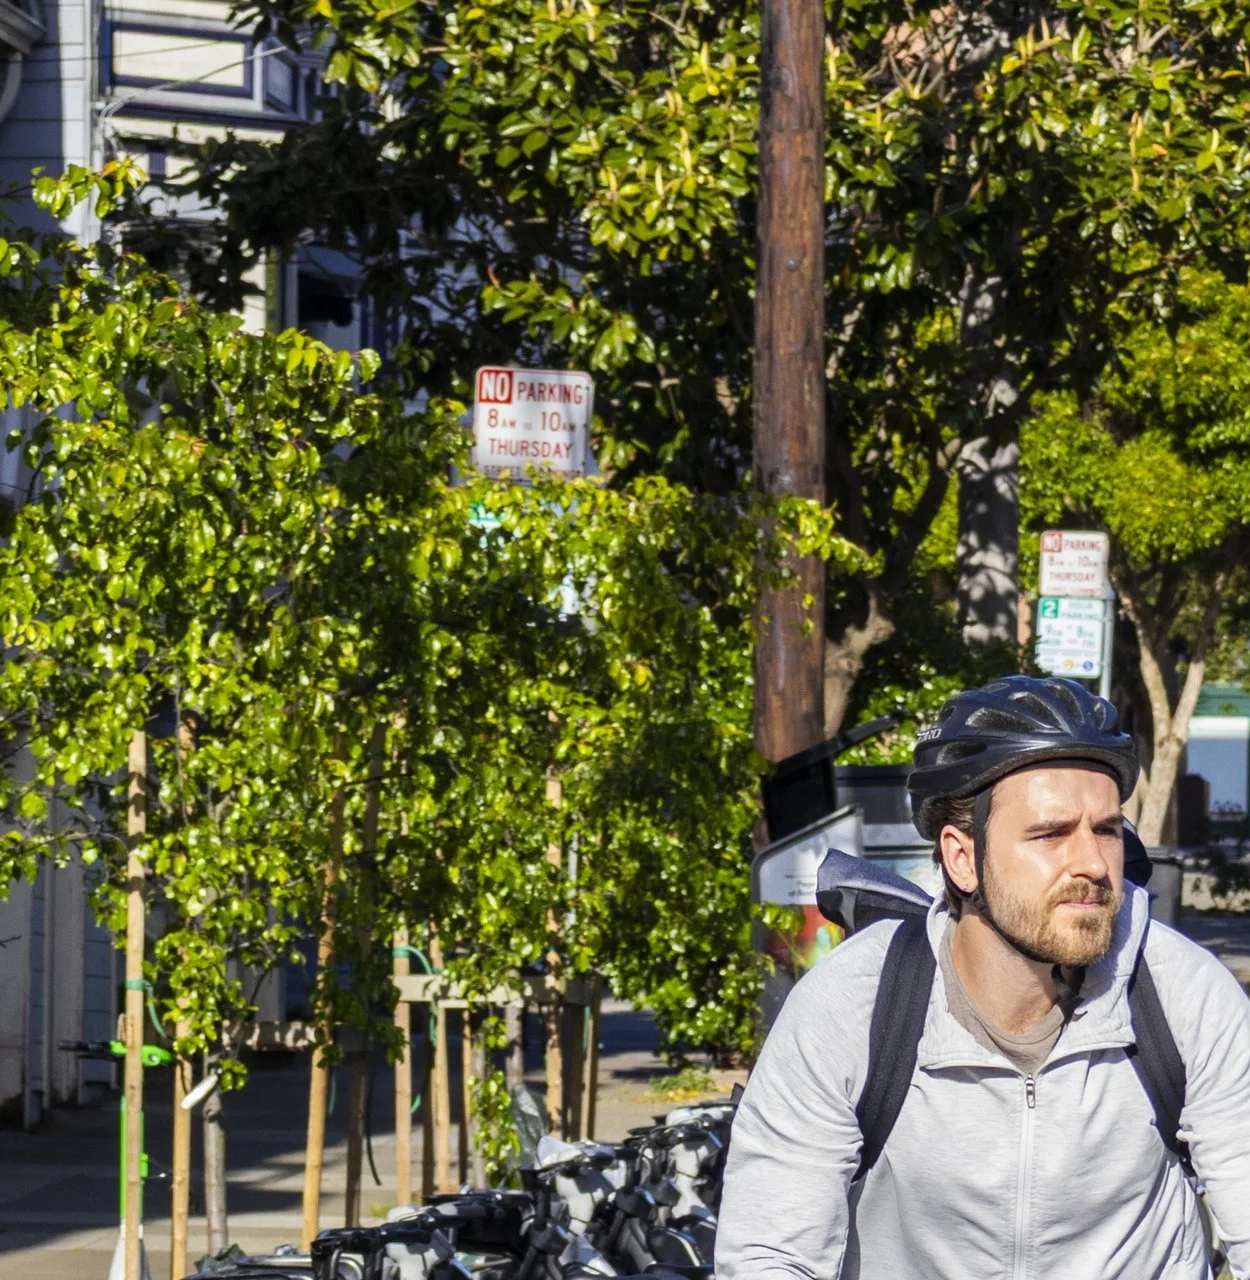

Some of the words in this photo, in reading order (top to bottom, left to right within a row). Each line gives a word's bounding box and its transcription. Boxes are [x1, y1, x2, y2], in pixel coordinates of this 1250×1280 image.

[481, 372, 511, 401] NO
[517, 382, 584, 405] PARKING
[488, 438, 573, 458] THURSDAY
[1064, 538, 1103, 552] PARKING
[1049, 571, 1096, 582] THURSDAY
[1044, 600, 1057, 618] 2
